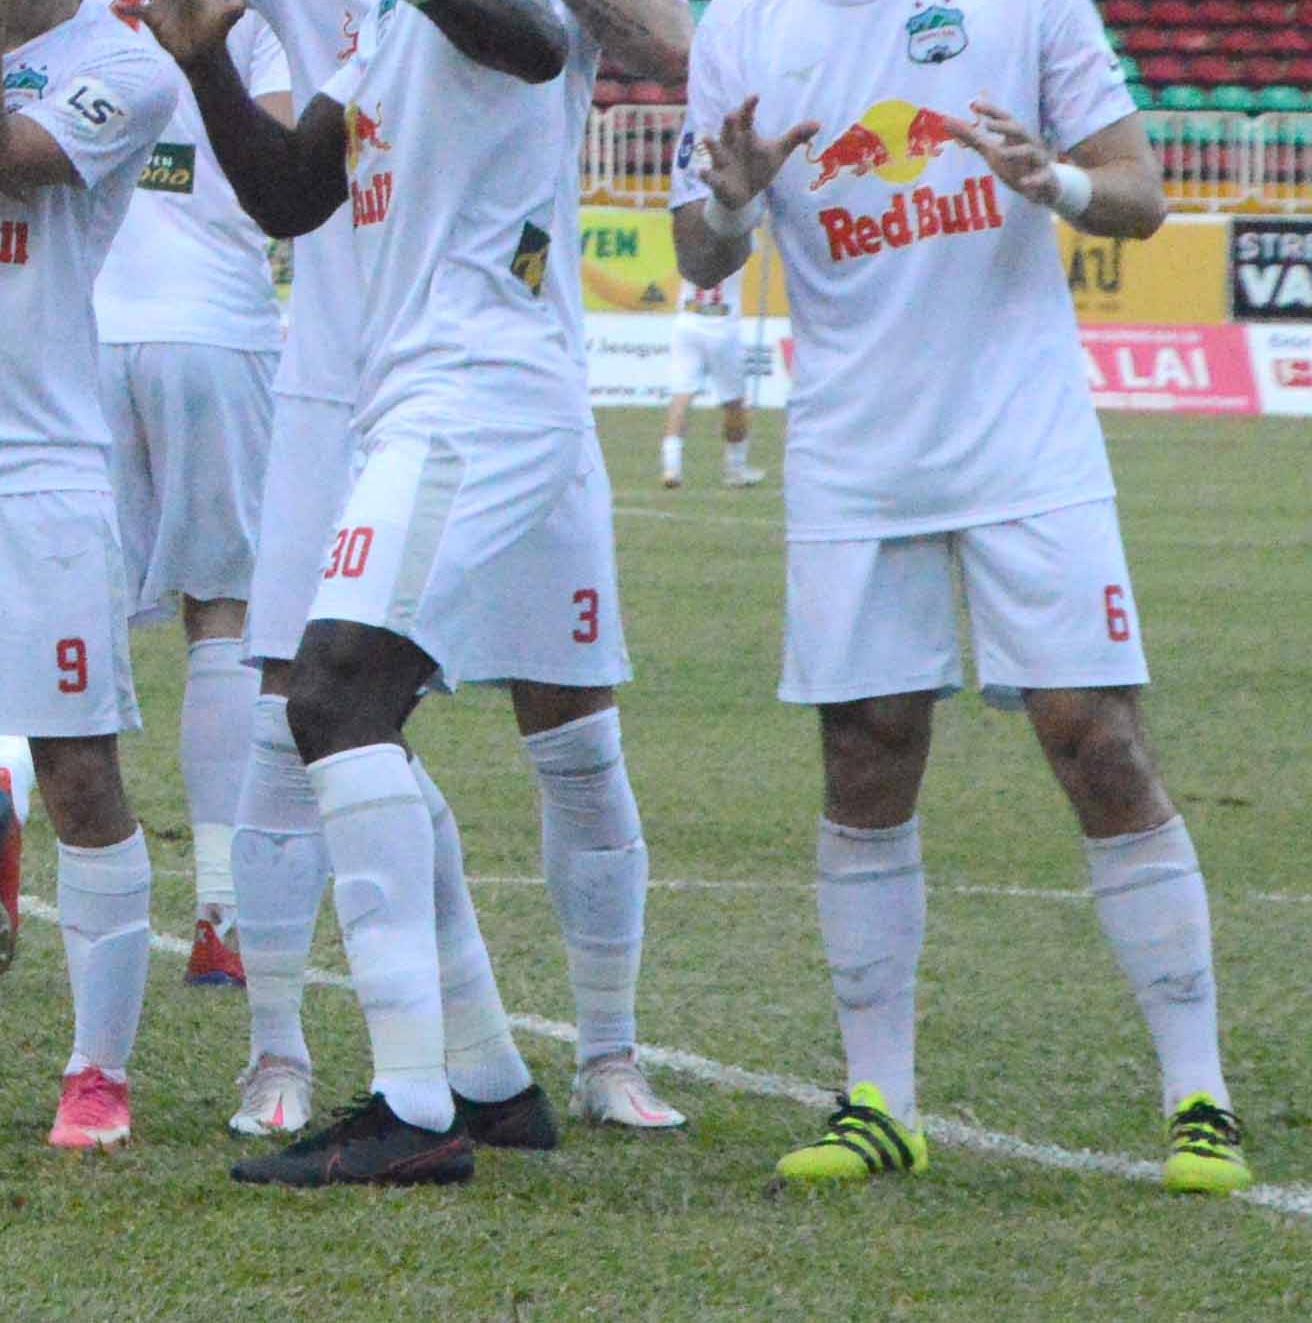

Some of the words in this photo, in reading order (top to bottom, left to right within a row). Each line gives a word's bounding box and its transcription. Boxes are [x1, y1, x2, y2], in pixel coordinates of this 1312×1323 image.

[66, 85, 116, 126] LS
[819, 192, 913, 263] Red
[912, 175, 1004, 242] Bull
[1116, 347, 1211, 390] LAI
[571, 588, 600, 645] 3
[1103, 583, 1132, 643] 6
[55, 637, 89, 694] 9
